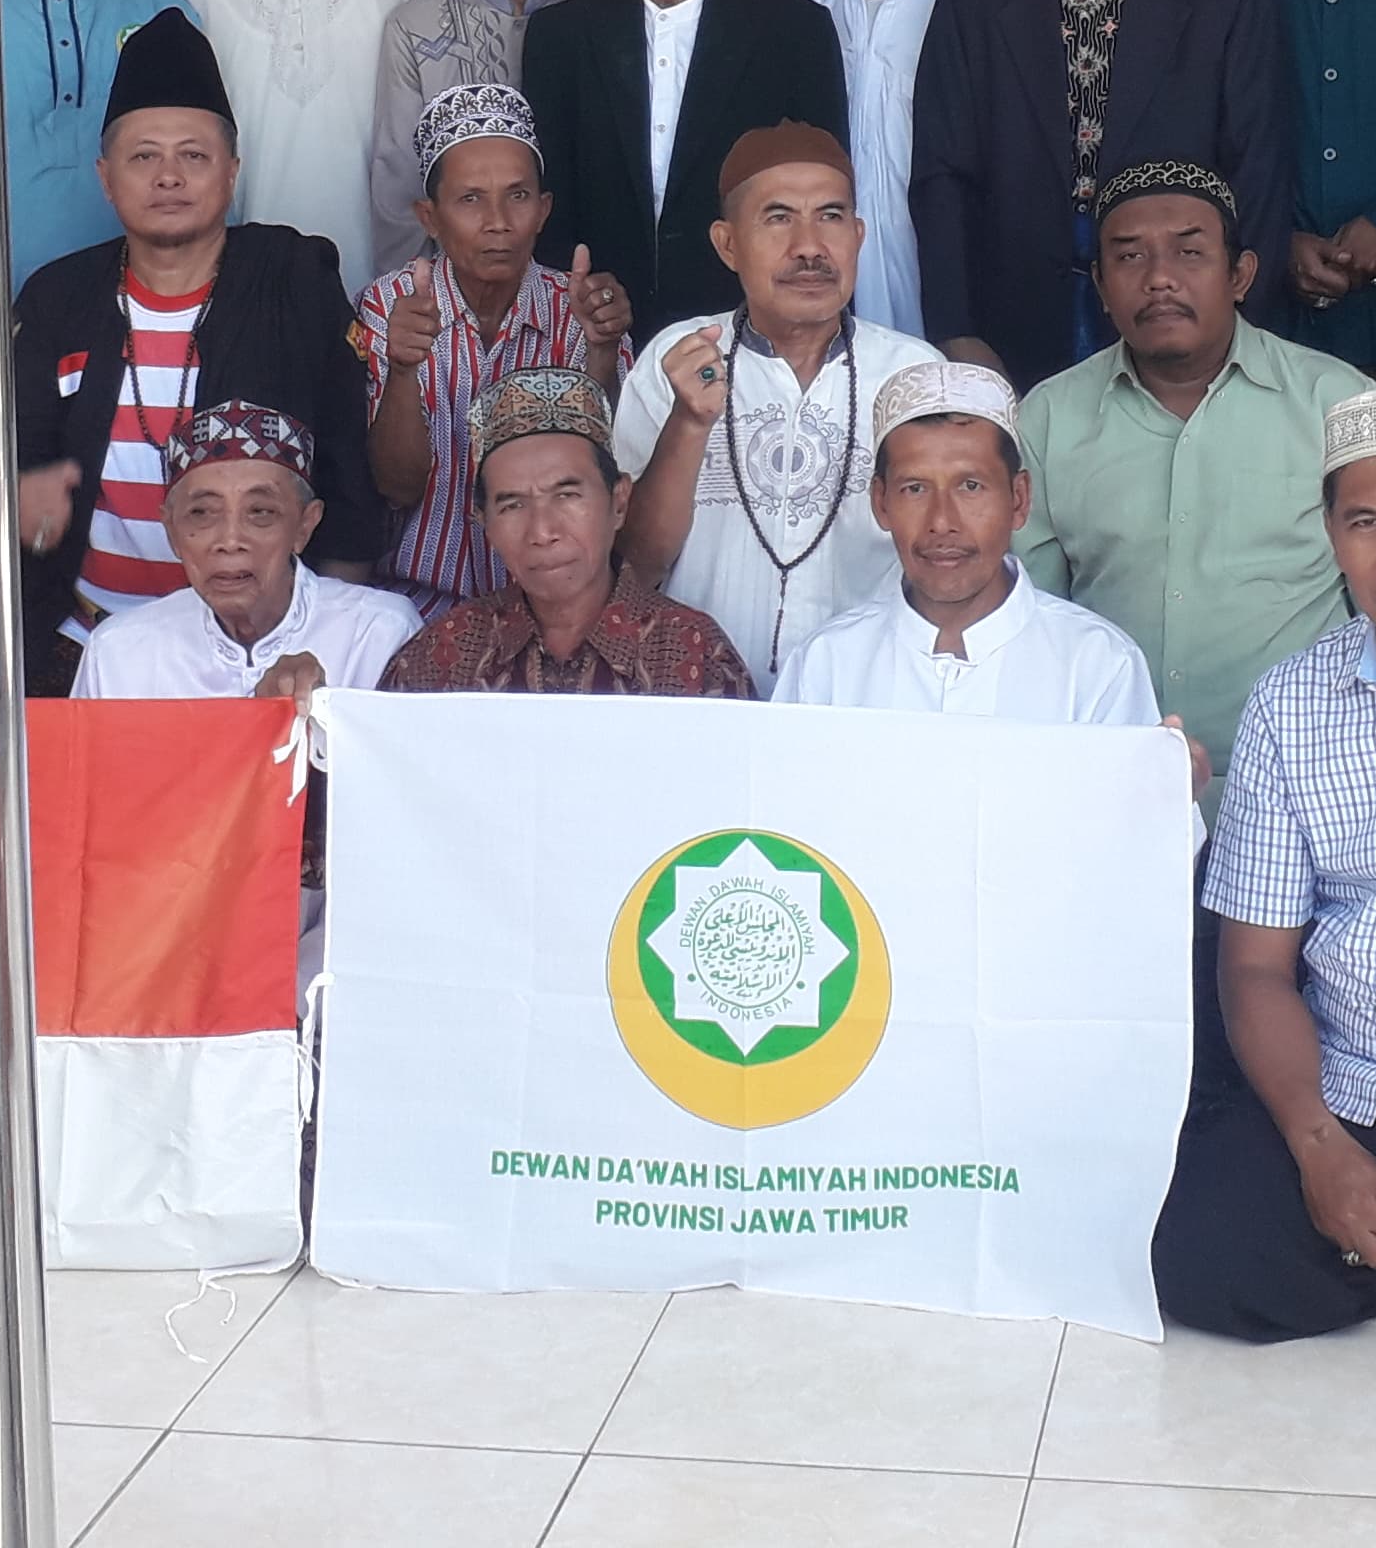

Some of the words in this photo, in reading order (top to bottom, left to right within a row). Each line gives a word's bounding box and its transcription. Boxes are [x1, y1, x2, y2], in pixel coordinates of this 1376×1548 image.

[680, 896, 707, 947] DEWAN
[708, 876, 764, 898] DA'WAH
[771, 885, 815, 955] ISLAMIYAH
[700, 990, 793, 1021] INDONESIA
[491, 1151, 590, 1181] DEWAN
[597, 1158, 708, 1188] DA'WAH
[715, 1165, 866, 1192] ISLAMIYAH
[874, 1164, 1020, 1193] INDONESIA
[596, 1200, 723, 1231] PROVINSI
[731, 1208, 816, 1233] JAWA
[823, 1206, 908, 1232] TIMUR
